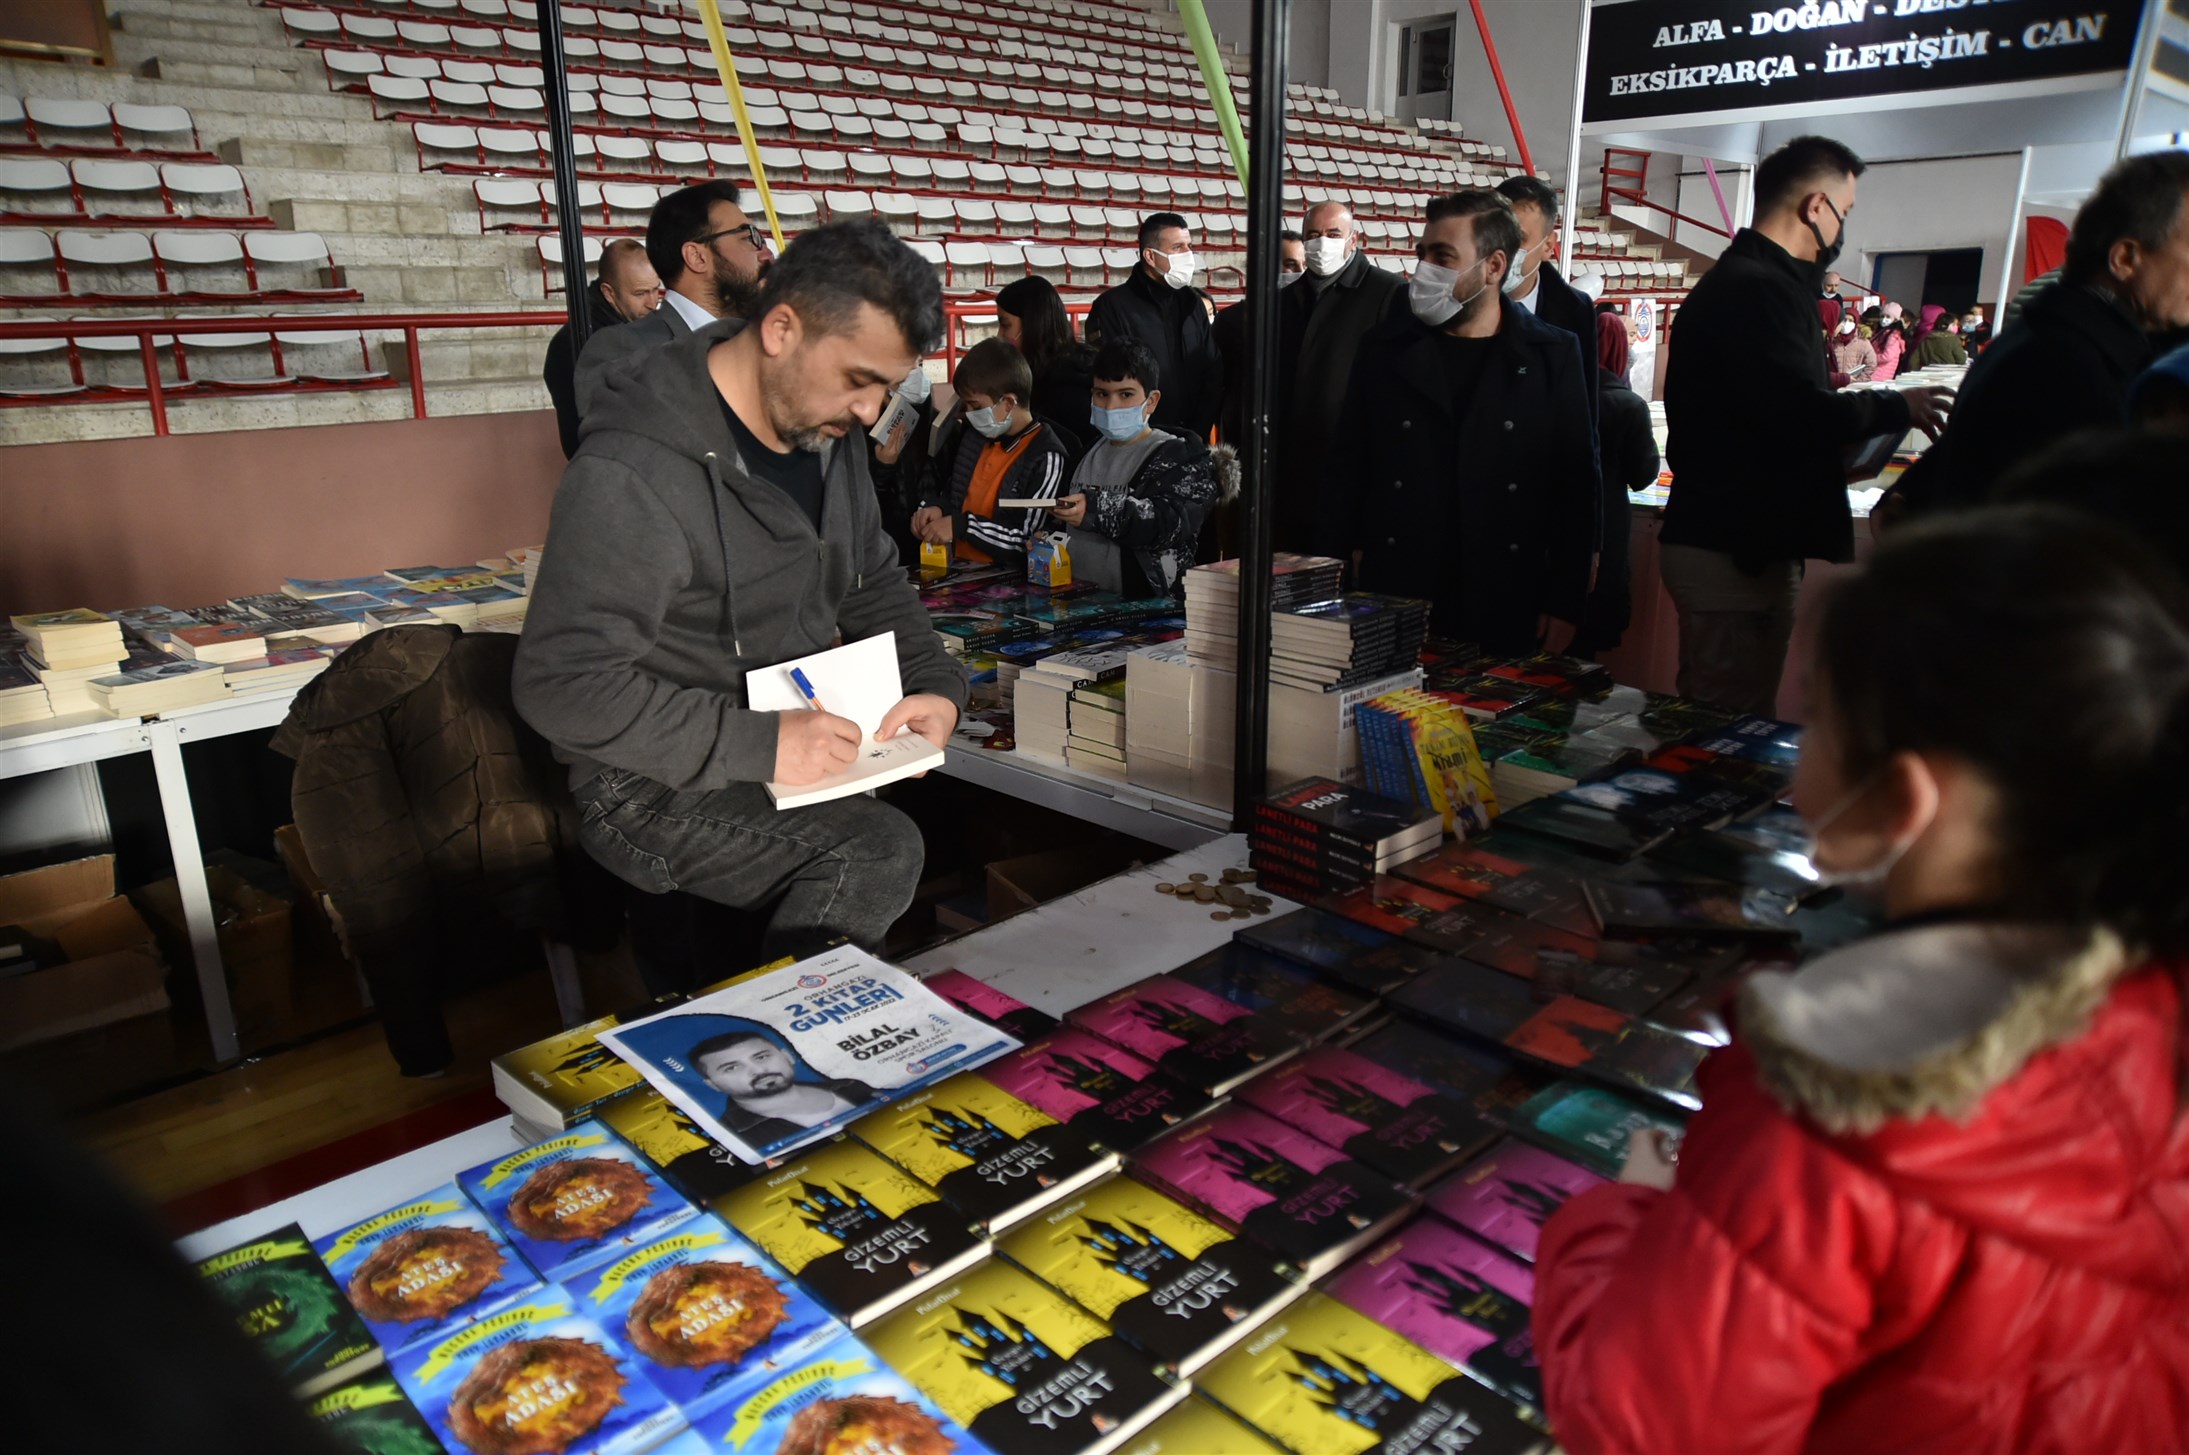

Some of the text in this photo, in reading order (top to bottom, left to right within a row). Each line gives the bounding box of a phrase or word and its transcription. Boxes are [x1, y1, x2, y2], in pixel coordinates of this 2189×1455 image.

[1653, 19, 1725, 48] ALFA
[1749, 0, 1868, 36] DOĞAN
[1609, 55, 1798, 96] EKSİKPARÇA
[1824, 28, 1991, 73] İLETİŞİM
[2023, 14, 2107, 49] CAN
[1301, 792, 1349, 810] PARA
[784, 1004, 811, 1018] 2
[836, 1023, 900, 1052] BİLAL
[851, 1028, 920, 1061] ÖZBAY
[986, 1145, 1056, 1187] YURT
[554, 1188, 615, 1220] ADASI
[853, 1226, 932, 1275] YURT
[397, 1261, 464, 1298] ADASI
[1164, 1269, 1239, 1320] YURT
[679, 1298, 745, 1340] ADASI
[504, 1379, 579, 1428] ADASI
[1029, 1369, 1115, 1431] YURT
